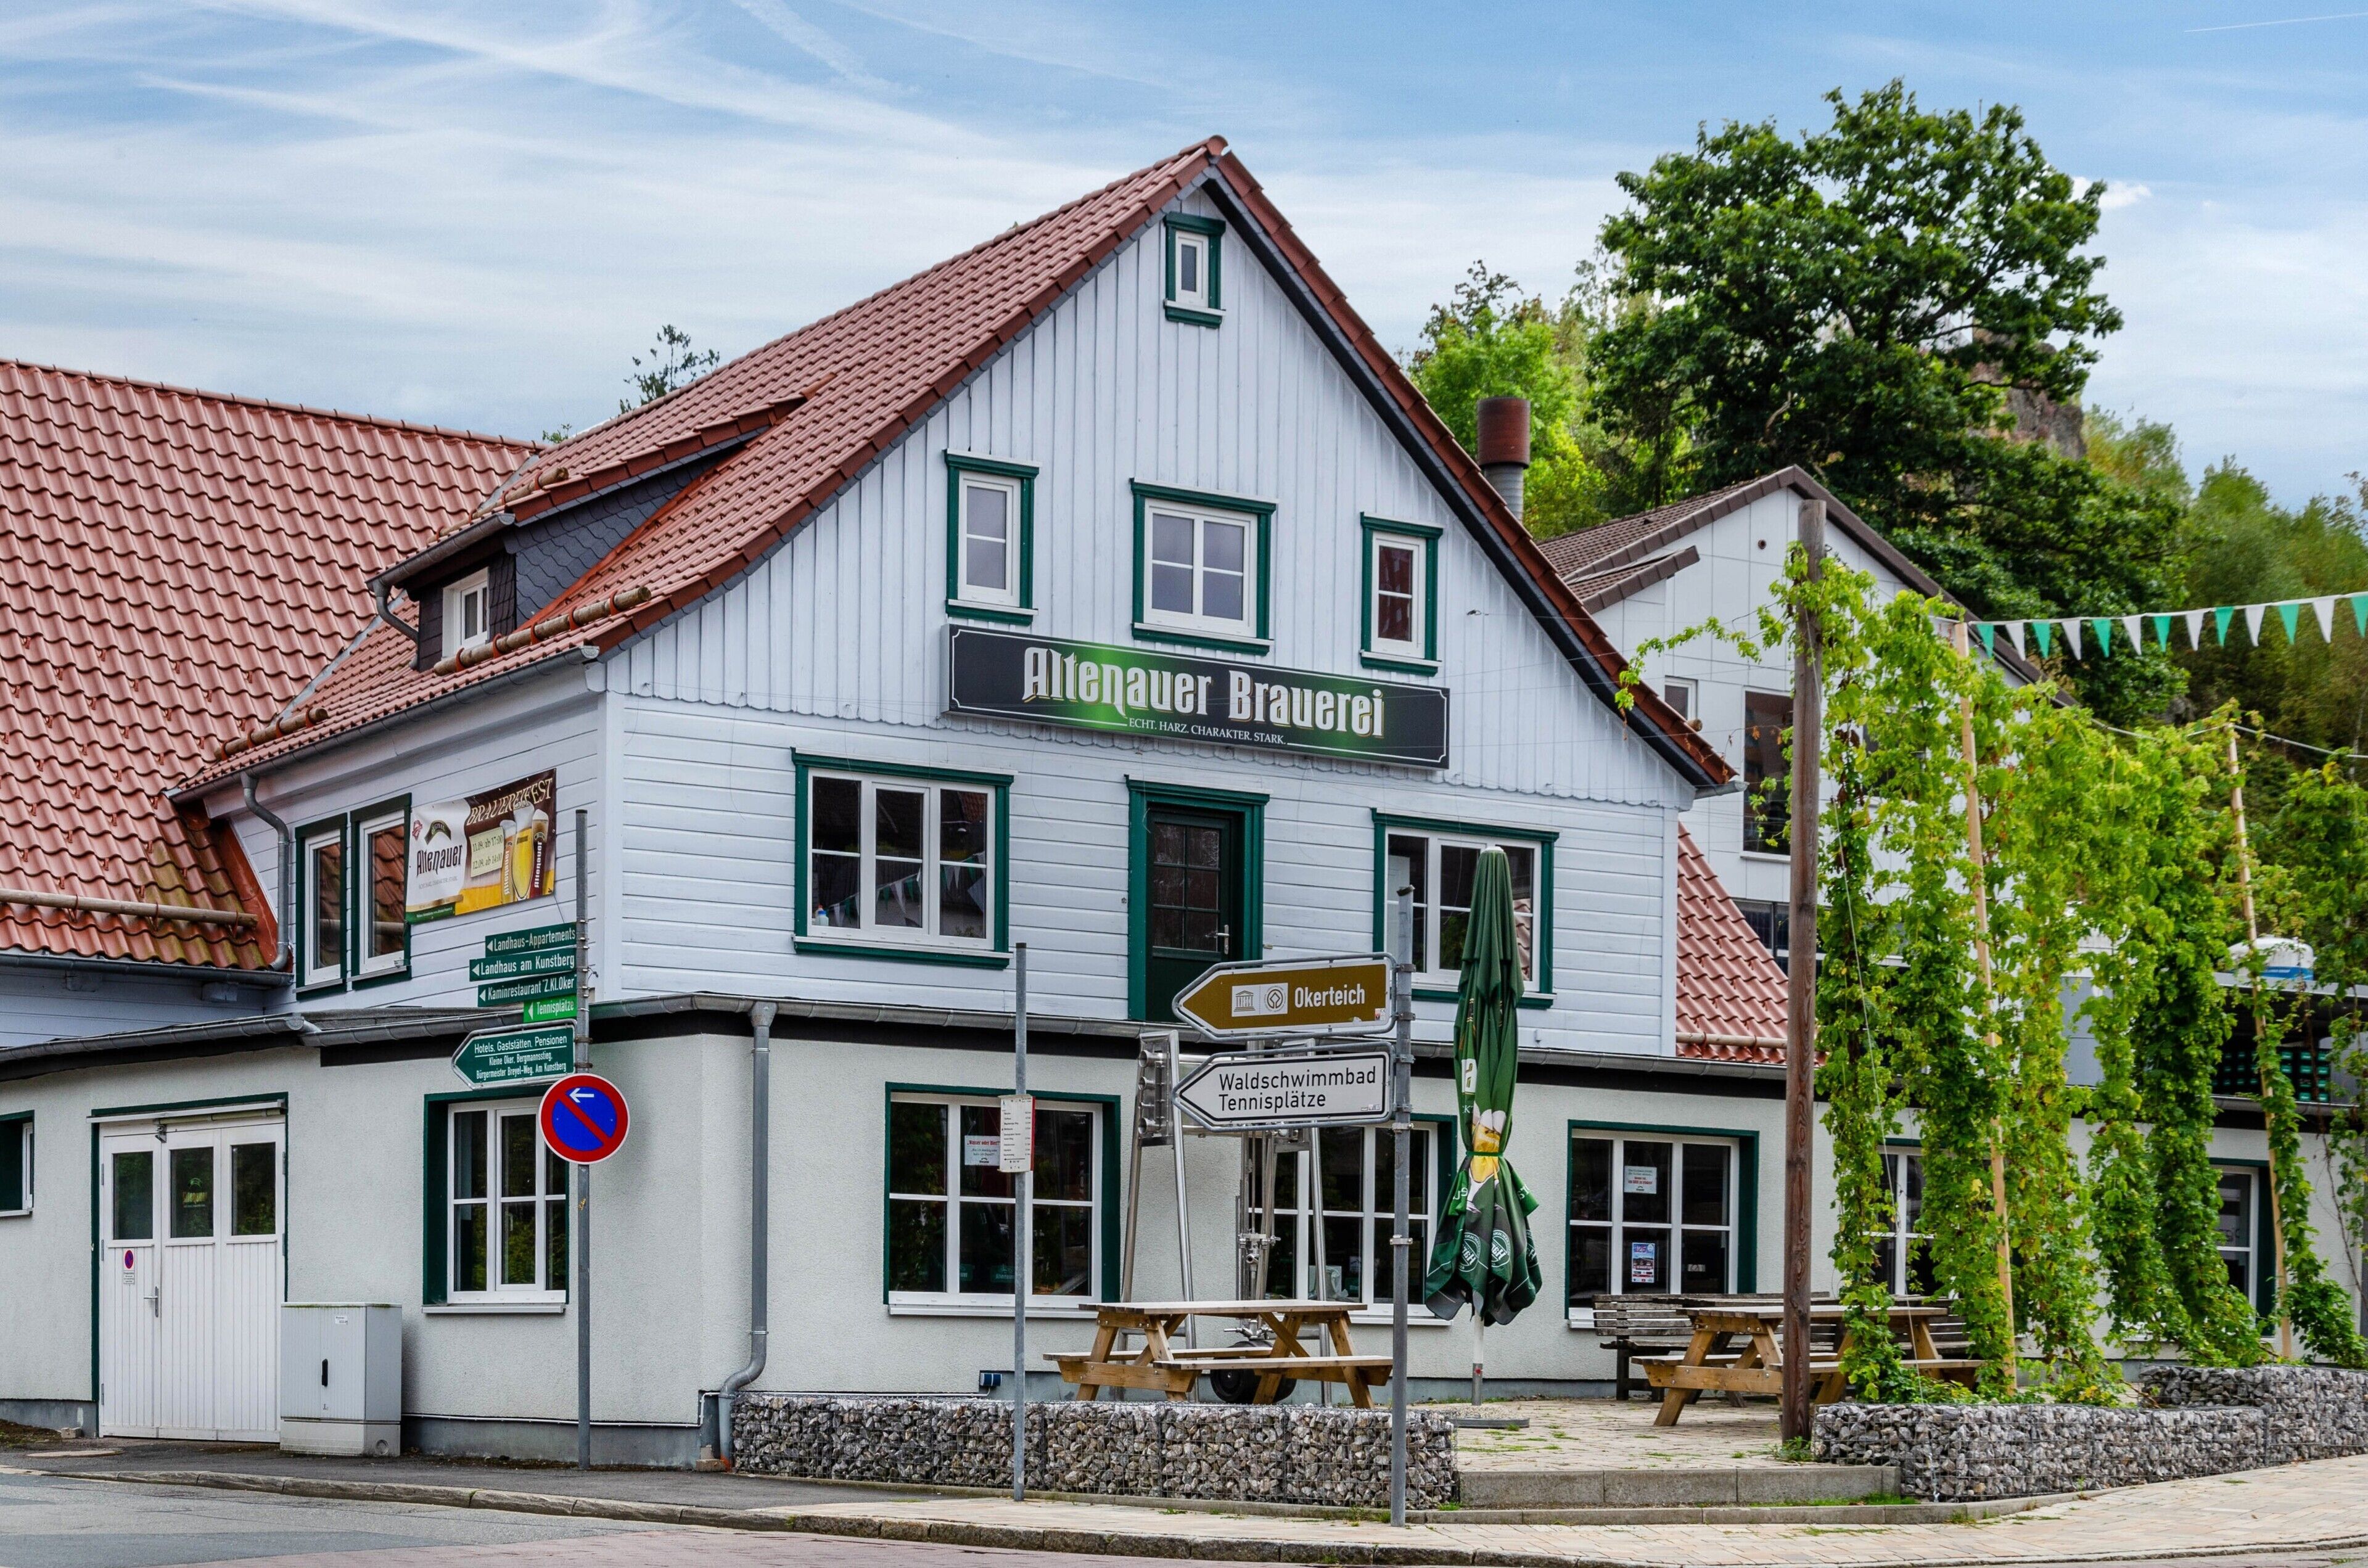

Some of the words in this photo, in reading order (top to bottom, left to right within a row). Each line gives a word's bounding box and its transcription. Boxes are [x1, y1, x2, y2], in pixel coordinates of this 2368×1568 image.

[1022, 647, 1213, 718] Altenauer
[1228, 670, 1384, 738] Brauerei
[1129, 718, 1157, 730] ECHT.
[1159, 721, 1189, 734] HARZ.
[1191, 724, 1252, 741] CHARAKTER.
[1254, 733, 1286, 745] STARK.
[466, 778, 553, 826] BRAUEREIFEST
[416, 844, 463, 878] Altenauer
[494, 927, 576, 951] Landhaus-Appartements
[481, 960, 517, 975] Landhaus
[520, 961, 532, 971] am
[535, 953, 575, 969] Kunstberg
[488, 982, 541, 1000] Kaminrestaurant
[1294, 983, 1365, 1009] Okerteich
[536, 998, 575, 1016] Tennisplätze
[535, 1035, 567, 1047] Pensionen
[476, 1068, 506, 1081] Bürgermeister
[535, 1064, 543, 1073] Am
[544, 1062, 567, 1072] Kunstberg
[489, 1056, 503, 1066] Kleine
[1219, 1065, 1376, 1091] Waldschwimmbad
[1219, 1090, 1326, 1114] Tennisplätze
